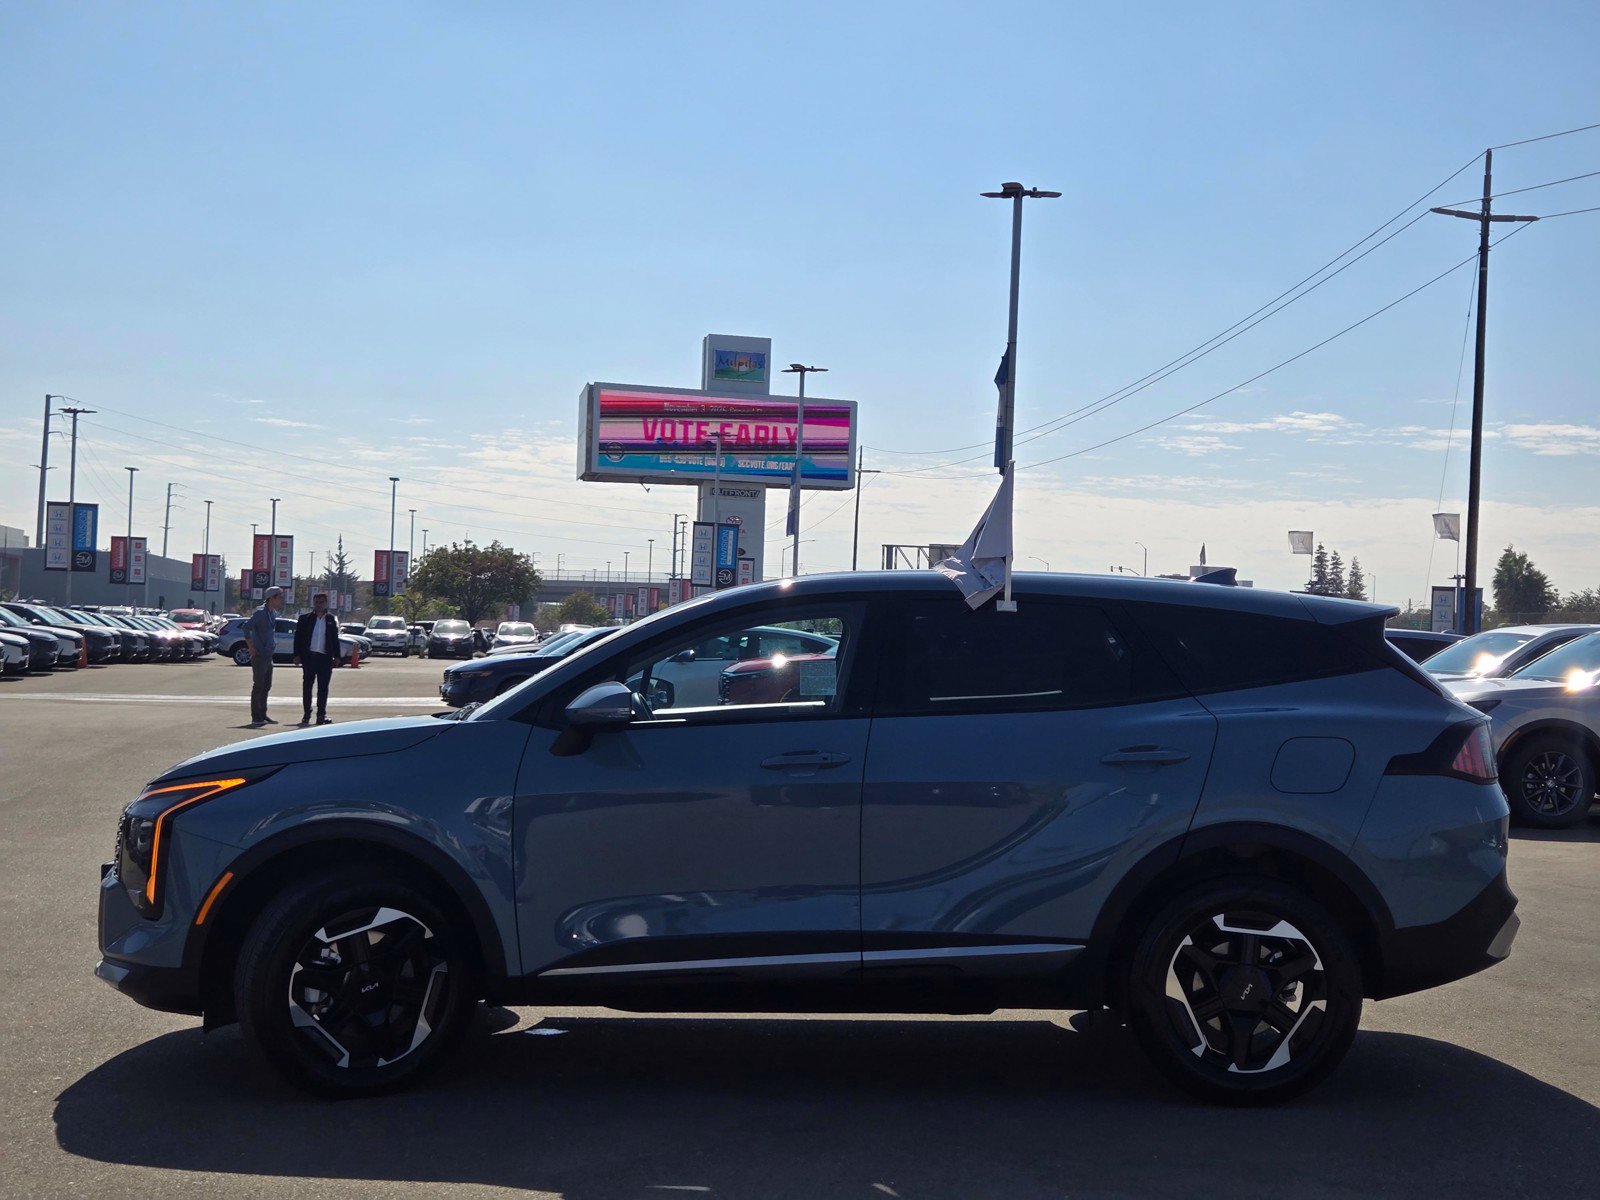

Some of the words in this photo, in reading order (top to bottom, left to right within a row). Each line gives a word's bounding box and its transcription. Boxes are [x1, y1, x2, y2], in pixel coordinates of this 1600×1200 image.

[642, 417, 710, 445] VOTE
[719, 422, 798, 446] EARLY
[720, 529, 729, 565] ENVISION
